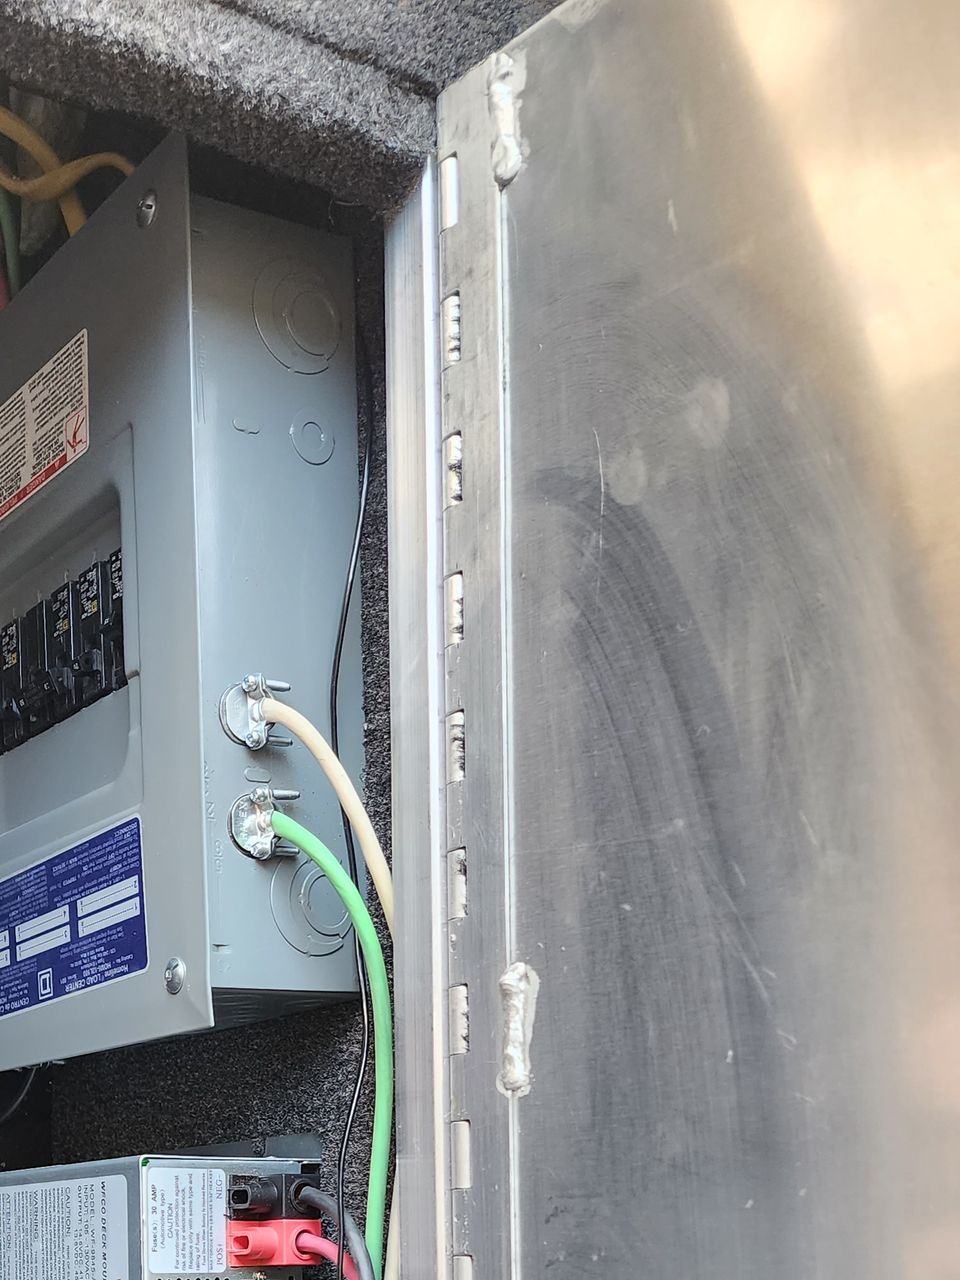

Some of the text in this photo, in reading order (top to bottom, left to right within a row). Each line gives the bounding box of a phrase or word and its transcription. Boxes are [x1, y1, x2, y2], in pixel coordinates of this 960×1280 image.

[64, 978, 85, 992] CENTER
[85, 973, 100, 985] LOAD
[10, 996, 29, 1009] CENTRO
[151, 1206, 156, 1214] 30
